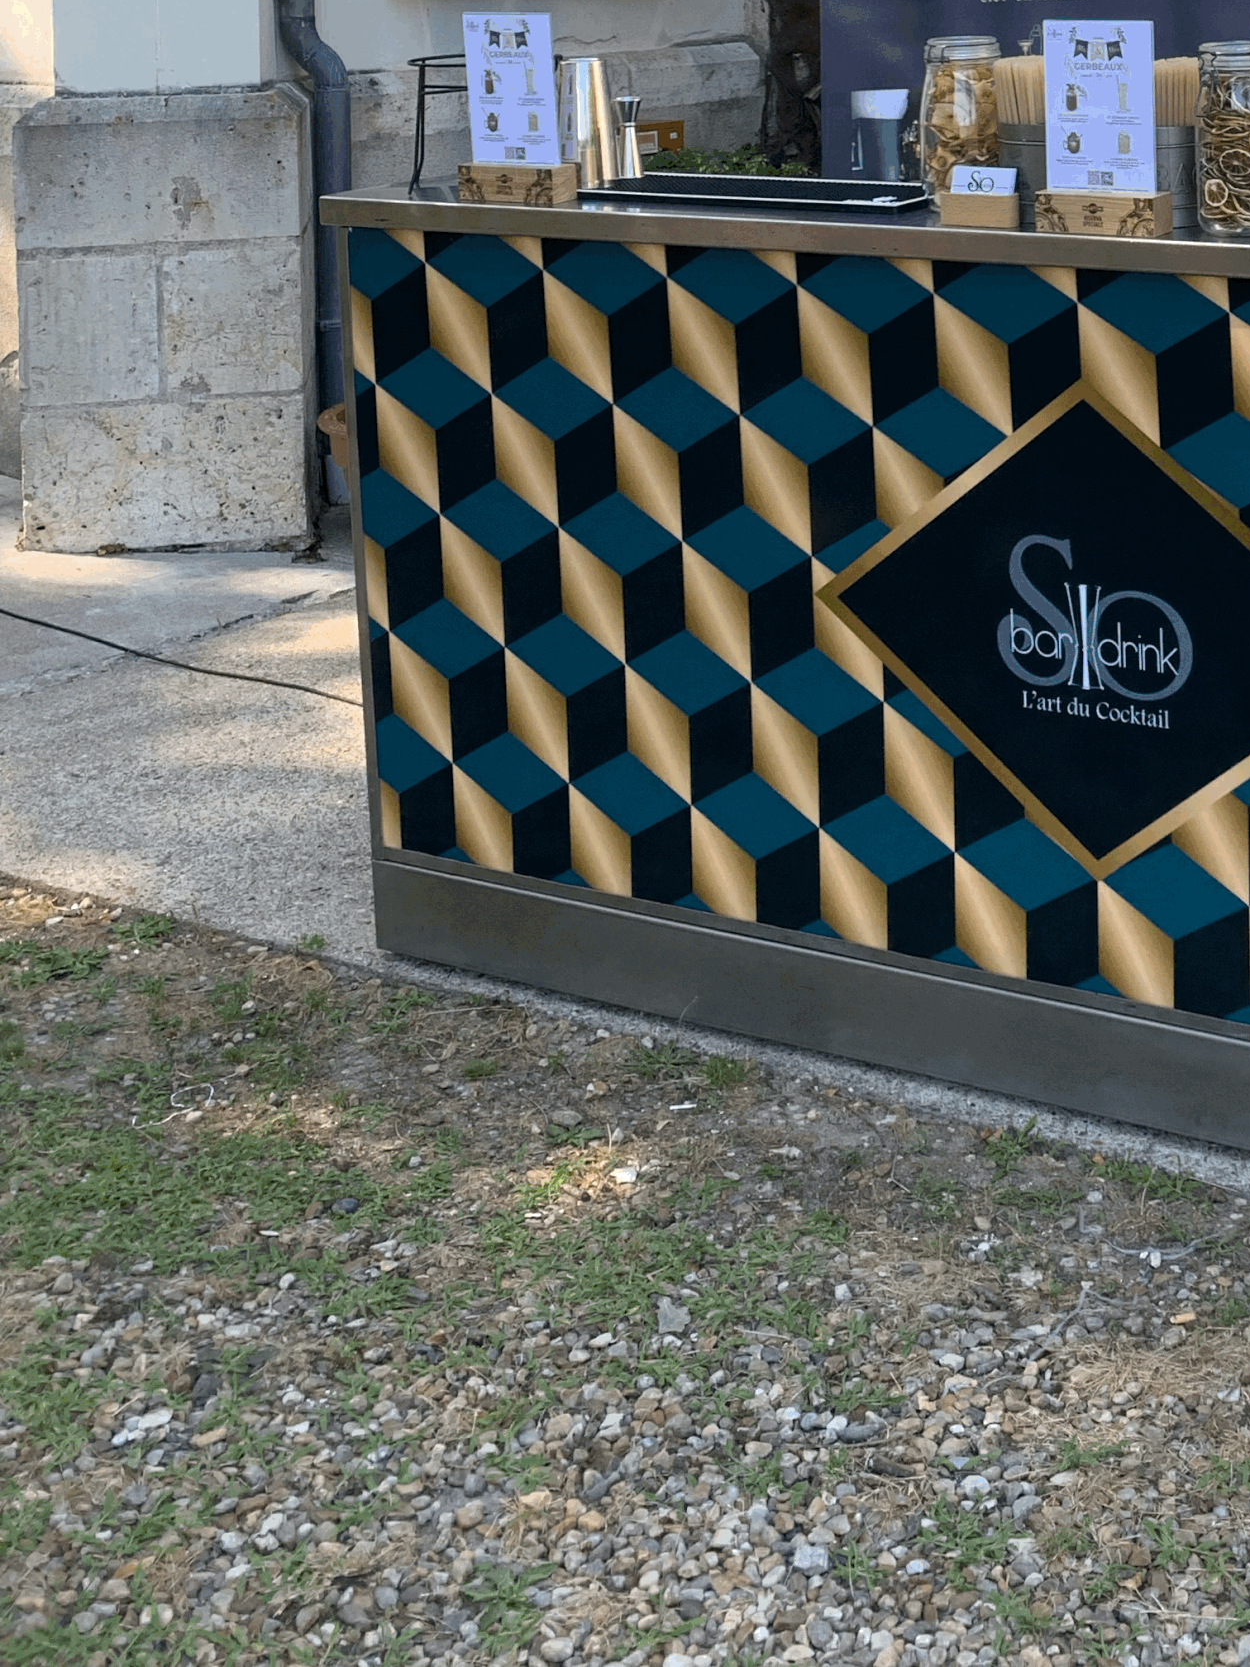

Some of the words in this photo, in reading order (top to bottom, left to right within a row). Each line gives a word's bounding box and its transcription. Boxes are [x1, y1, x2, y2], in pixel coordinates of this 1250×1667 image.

[1073, 62, 1124, 71] GERBEAUX
[1009, 607, 1074, 660] bar
[1098, 621, 1180, 676] drink
[1022, 689, 1063, 714] L'art
[1066, 696, 1091, 718] du
[1095, 701, 1170, 730] Cocktail
